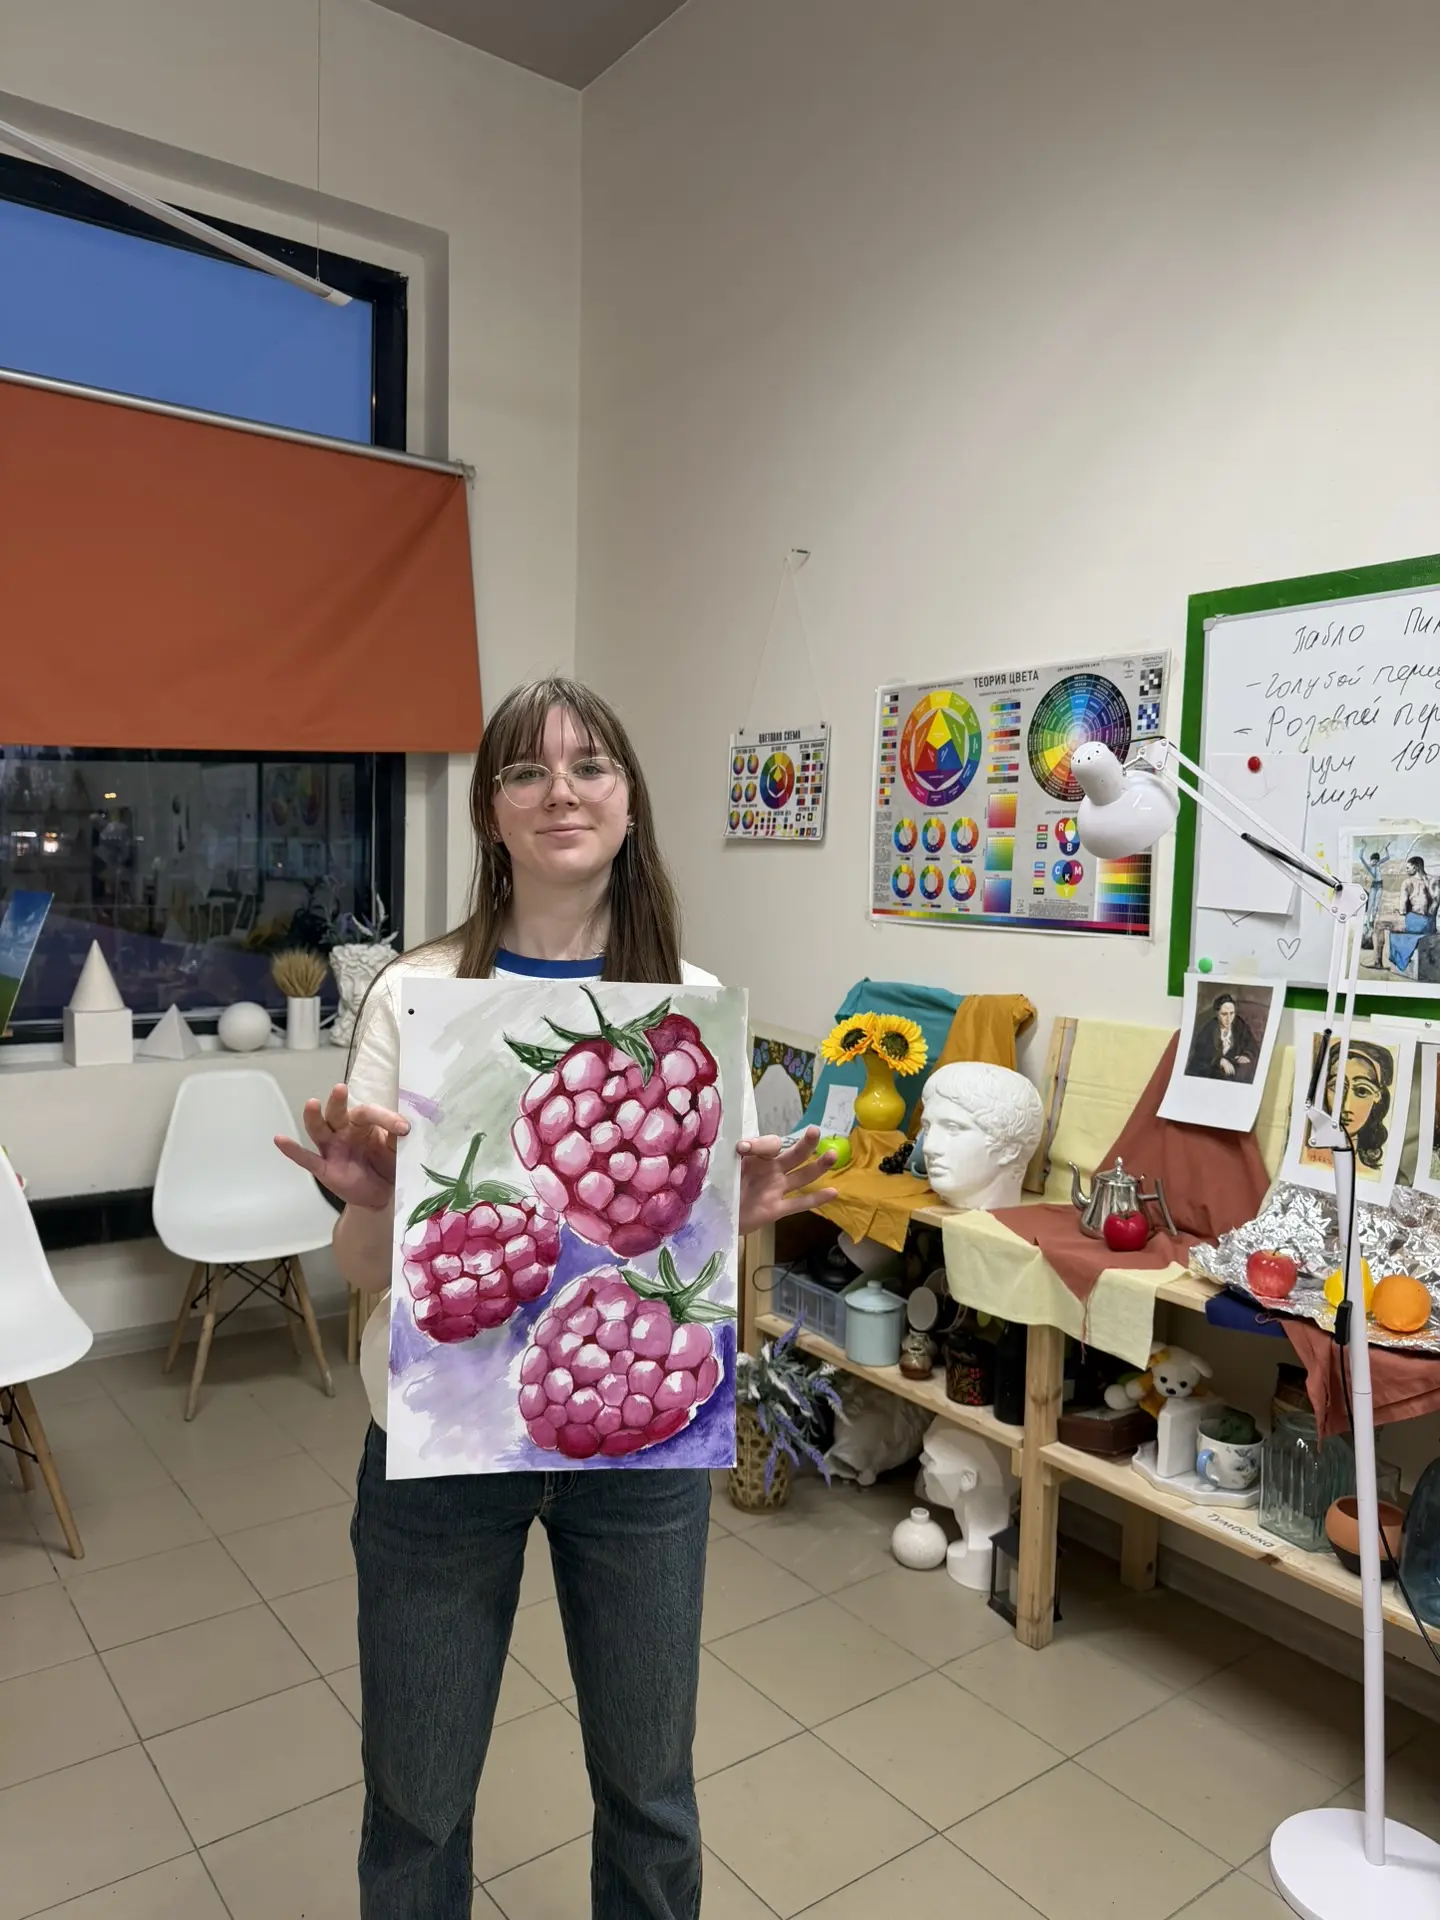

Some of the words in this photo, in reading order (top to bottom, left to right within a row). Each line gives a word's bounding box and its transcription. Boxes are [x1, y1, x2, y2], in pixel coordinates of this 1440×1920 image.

[1293, 621, 1365, 654] Пабло
[973, 674, 1007, 688] ТЕОРИЯ
[1009, 670, 1039, 685] ЦВЕТА
[1058, 822, 1065, 832] R
[1066, 842, 1073, 852] B
[1054, 866, 1061, 875] C
[1074, 866, 1082, 876] M
[1064, 873, 1070, 882] K
[1063, 887, 1070, 897] Y
